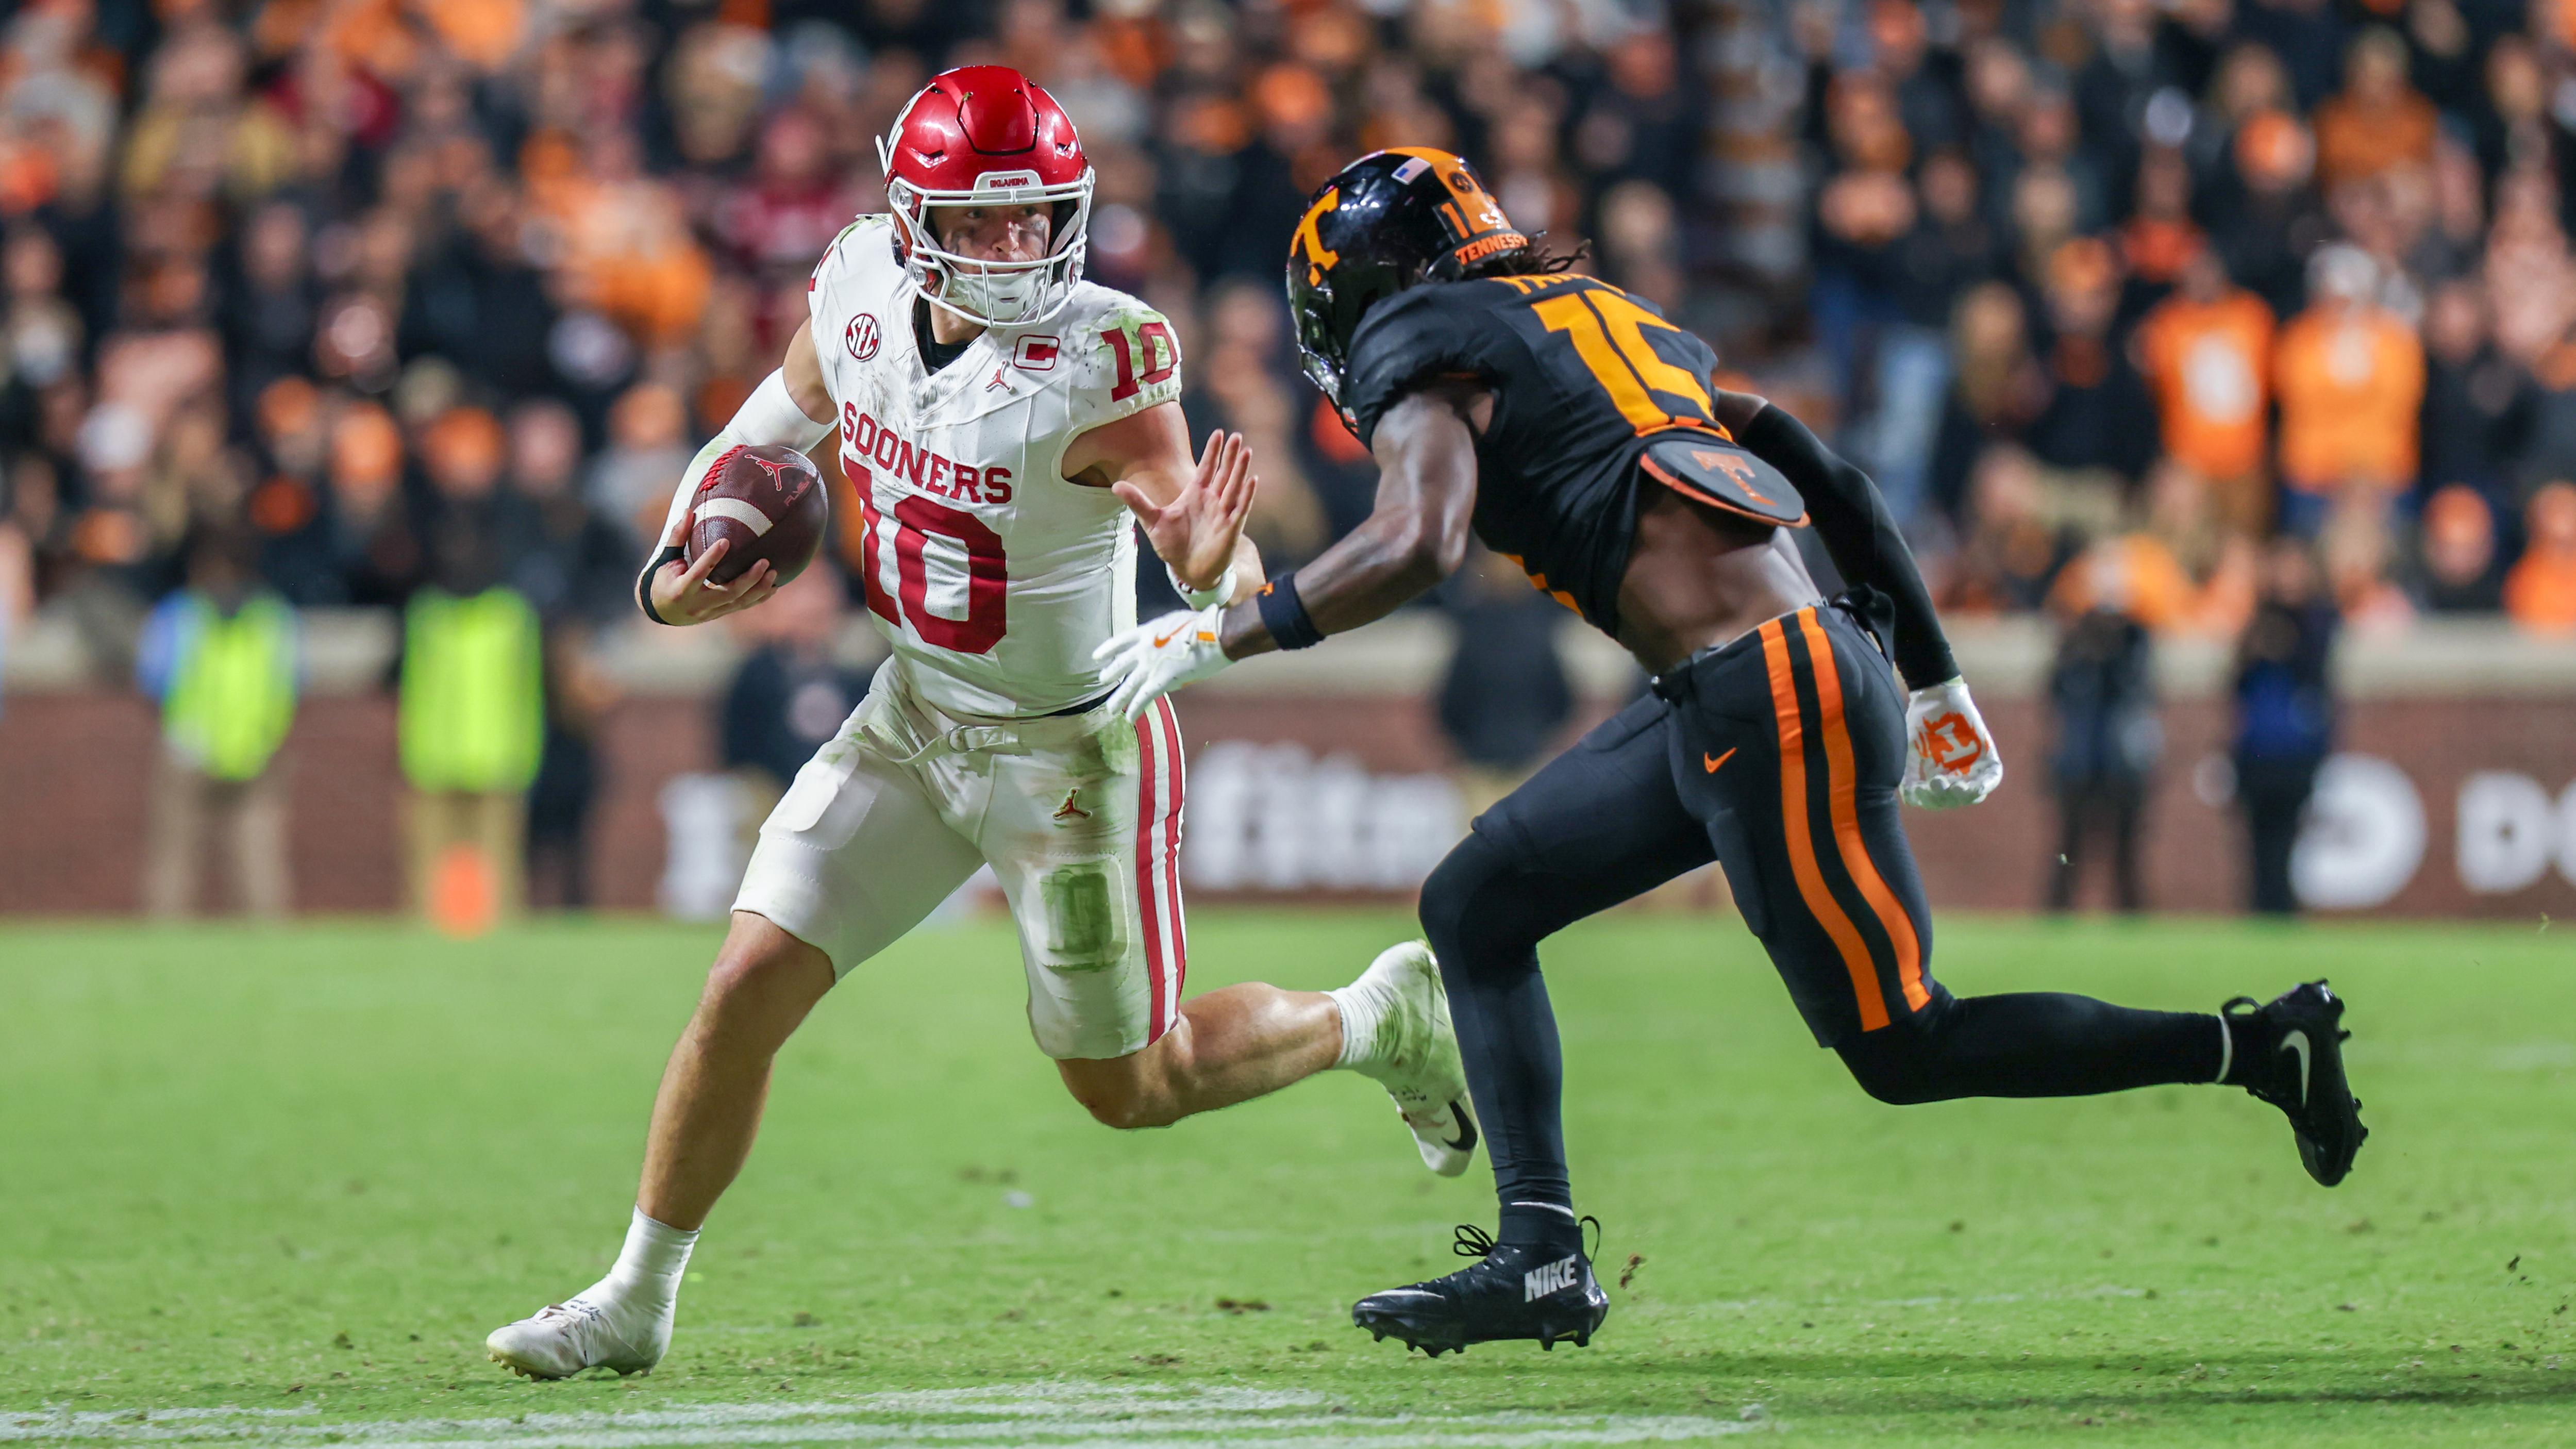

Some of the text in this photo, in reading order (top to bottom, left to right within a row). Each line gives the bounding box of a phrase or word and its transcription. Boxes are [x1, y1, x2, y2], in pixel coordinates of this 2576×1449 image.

[990, 176, 1030, 188] OKLAHOMA
[847, 315, 878, 358] SEC
[1101, 322, 1178, 403] 10
[1531, 288, 1736, 444] 15
[843, 401, 1012, 504] SOONERS
[843, 452, 1009, 655] 10
[1525, 1253, 1578, 1303] NIKE
